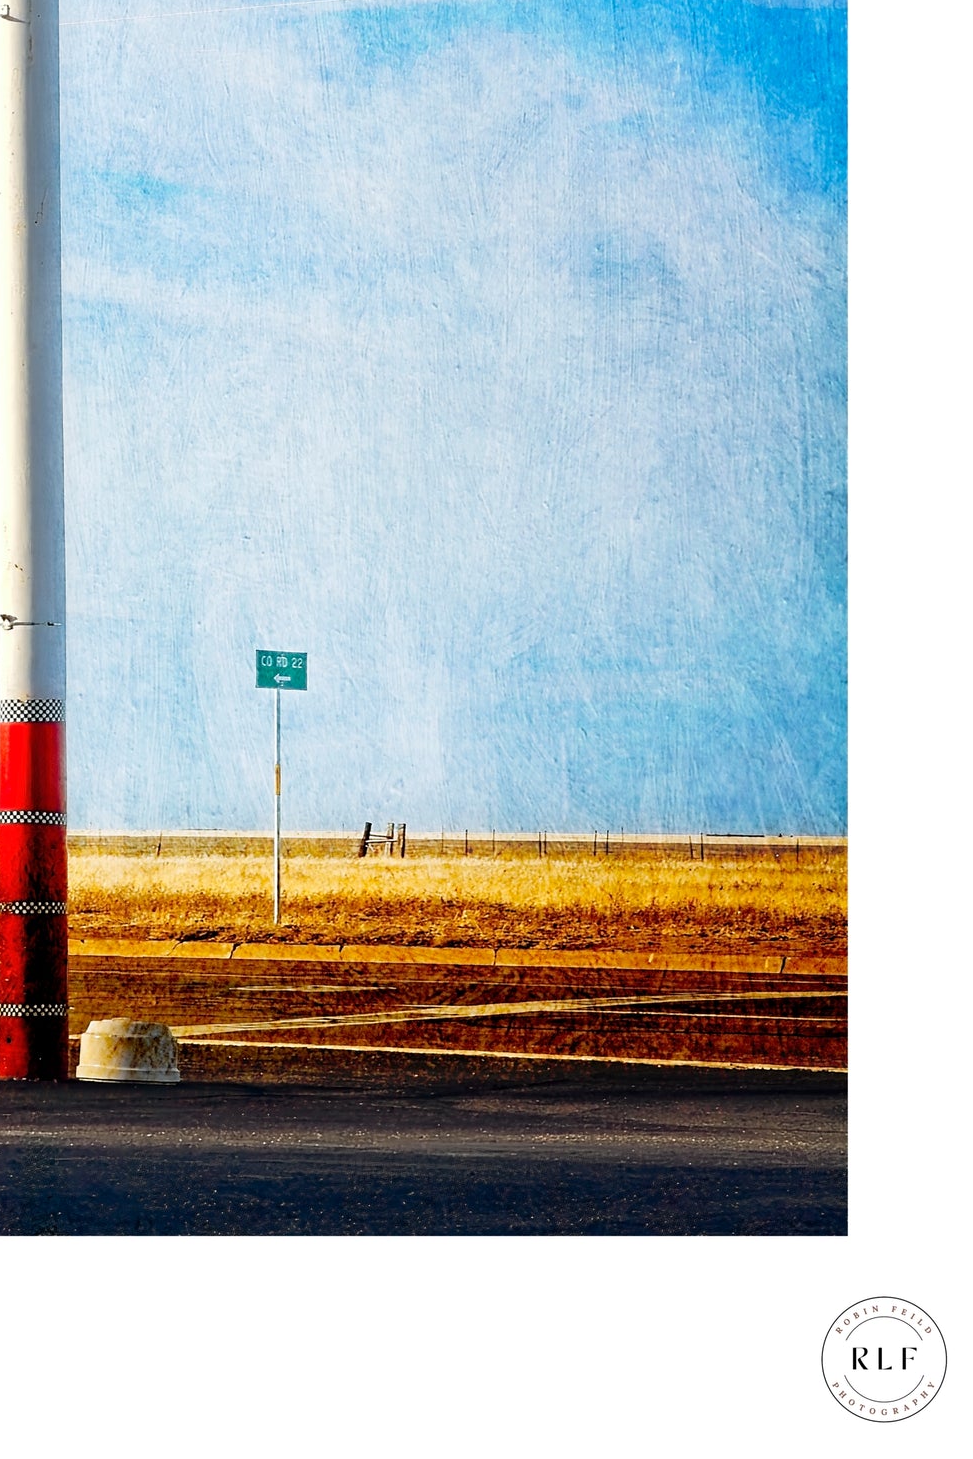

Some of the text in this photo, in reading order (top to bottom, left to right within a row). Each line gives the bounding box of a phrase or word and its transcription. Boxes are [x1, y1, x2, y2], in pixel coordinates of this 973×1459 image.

[261, 655, 303, 669] CO RD 22
